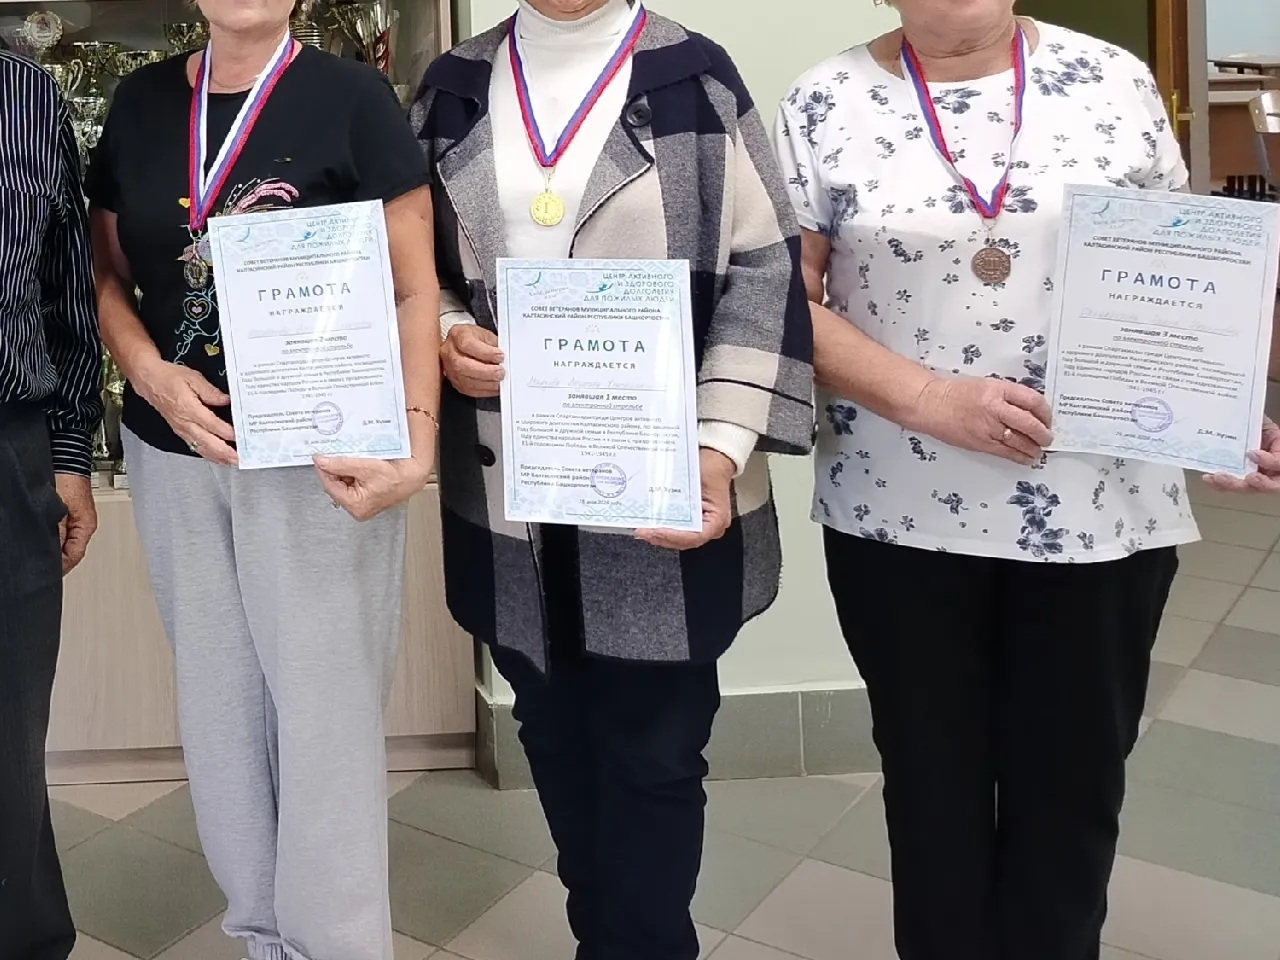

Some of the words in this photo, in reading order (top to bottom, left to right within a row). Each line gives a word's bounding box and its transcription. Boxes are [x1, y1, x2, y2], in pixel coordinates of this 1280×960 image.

[1101, 268, 1216, 294] ГРАМОТА
[258, 281, 350, 301] ГРАМОТА
[1109, 292, 1202, 310] НАГРАЖДАЕТСЯ
[544, 338, 645, 352] ГРАМОТА
[554, 360, 635, 369] НАГРАЖДАЕТСЯ
